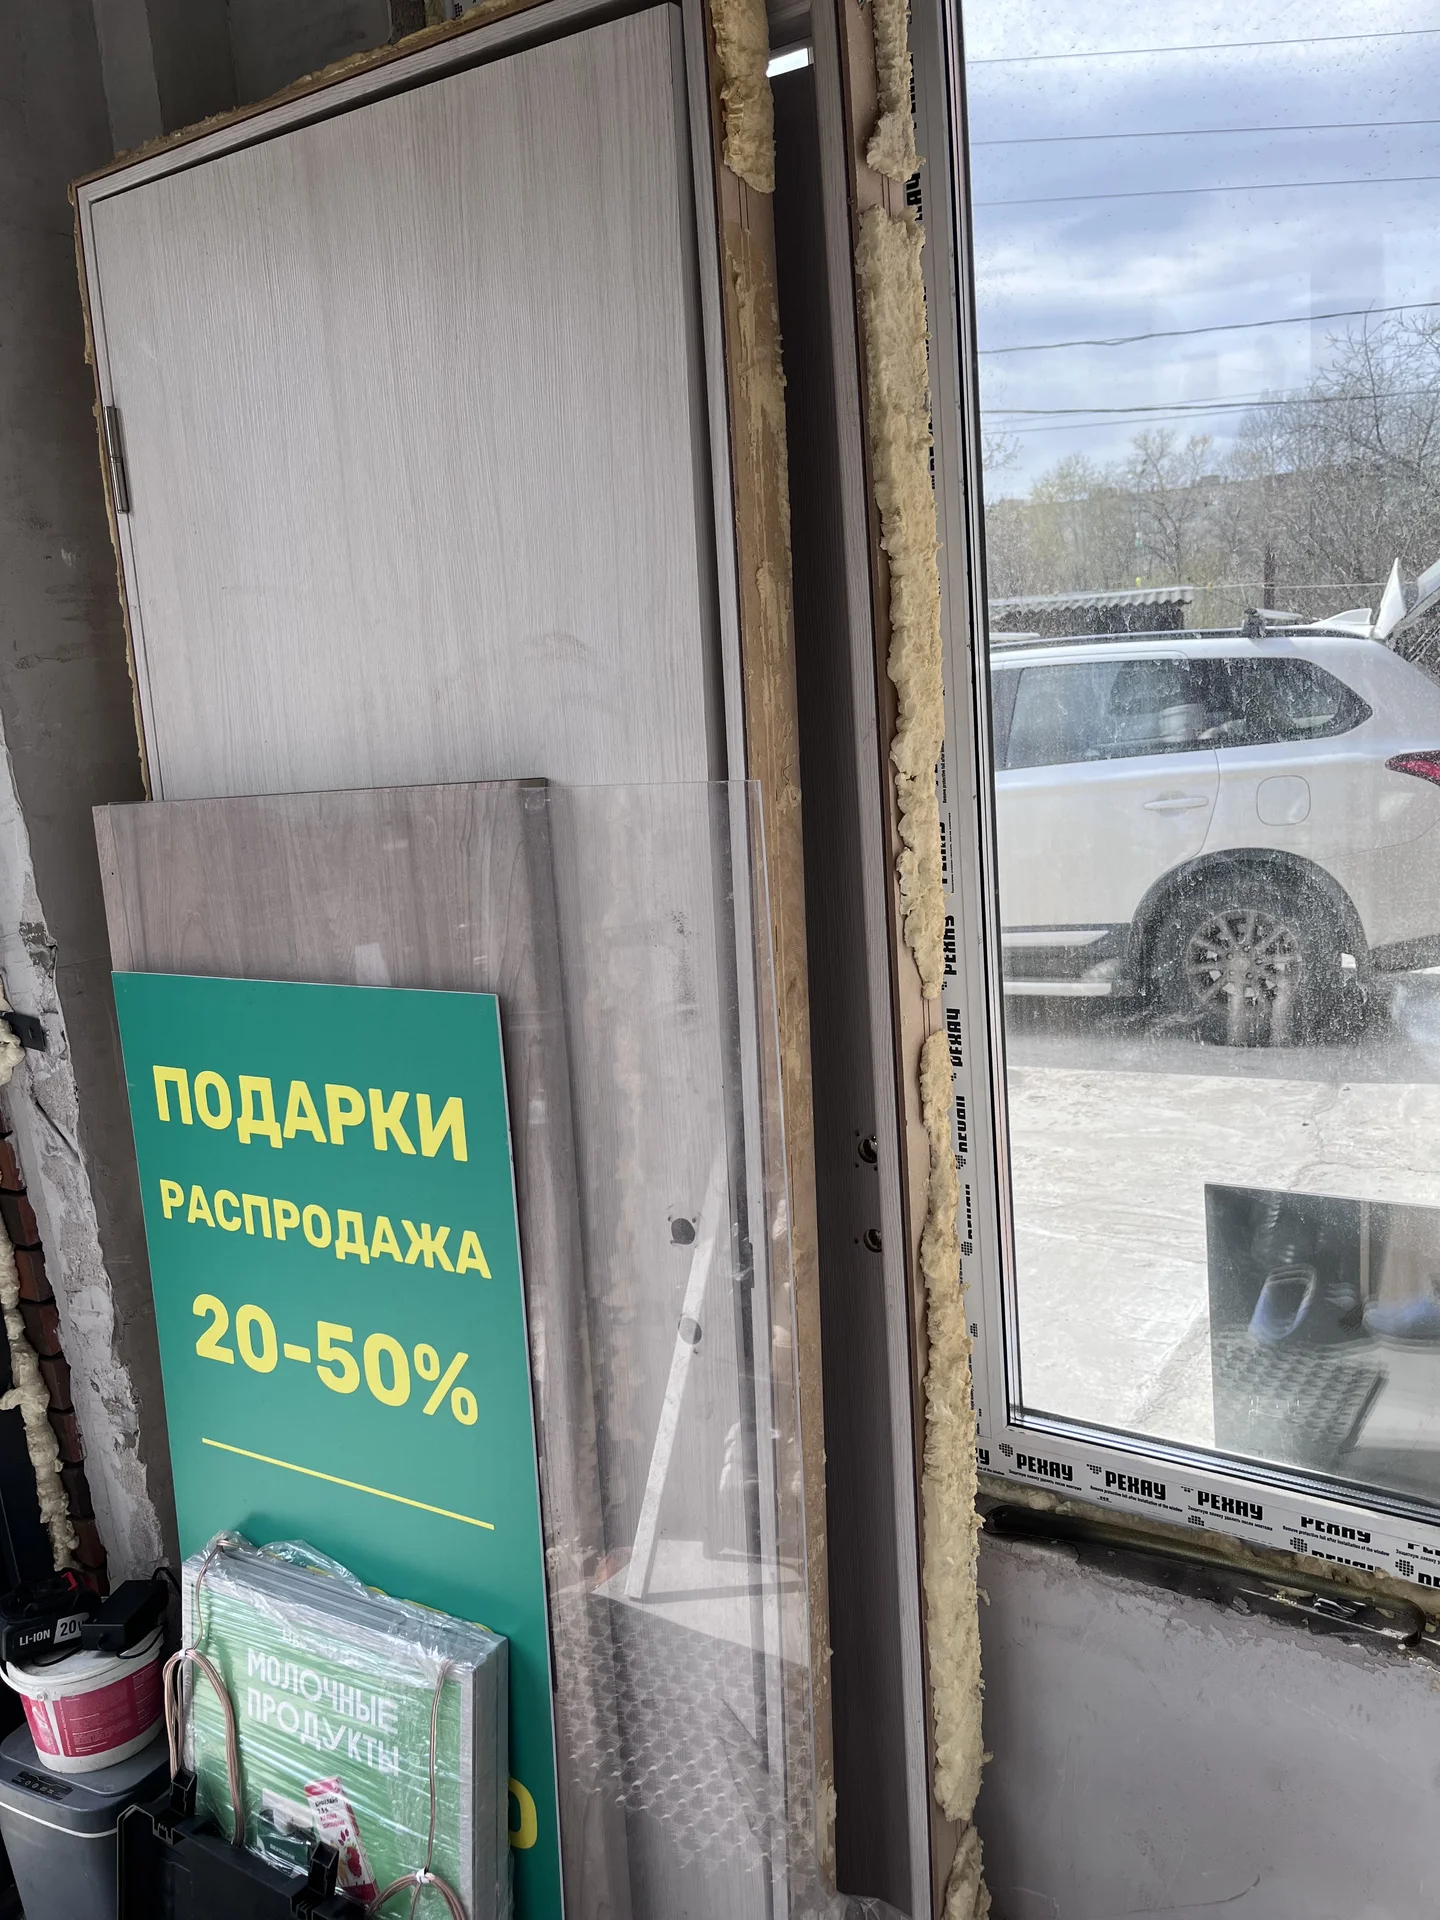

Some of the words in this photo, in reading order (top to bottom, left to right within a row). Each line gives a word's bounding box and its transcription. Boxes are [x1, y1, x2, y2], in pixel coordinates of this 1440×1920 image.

[152, 1065, 468, 1161] ПОДАРКИ
[158, 1179, 492, 1280] РАСПРОДАЖА
[193, 1294, 478, 1425] 20-50%
[1016, 1452, 1073, 1482] РЕХАУ
[1105, 1470, 1166, 1501] РЕХАУ
[1197, 1489, 1263, 1521] РЕХАУ
[19, 1628, 51, 1646] LI-ION
[247, 1648, 399, 1735] МОЛОЧНЫЕ
[247, 1686, 399, 1777] ПРОДУКТЫ
